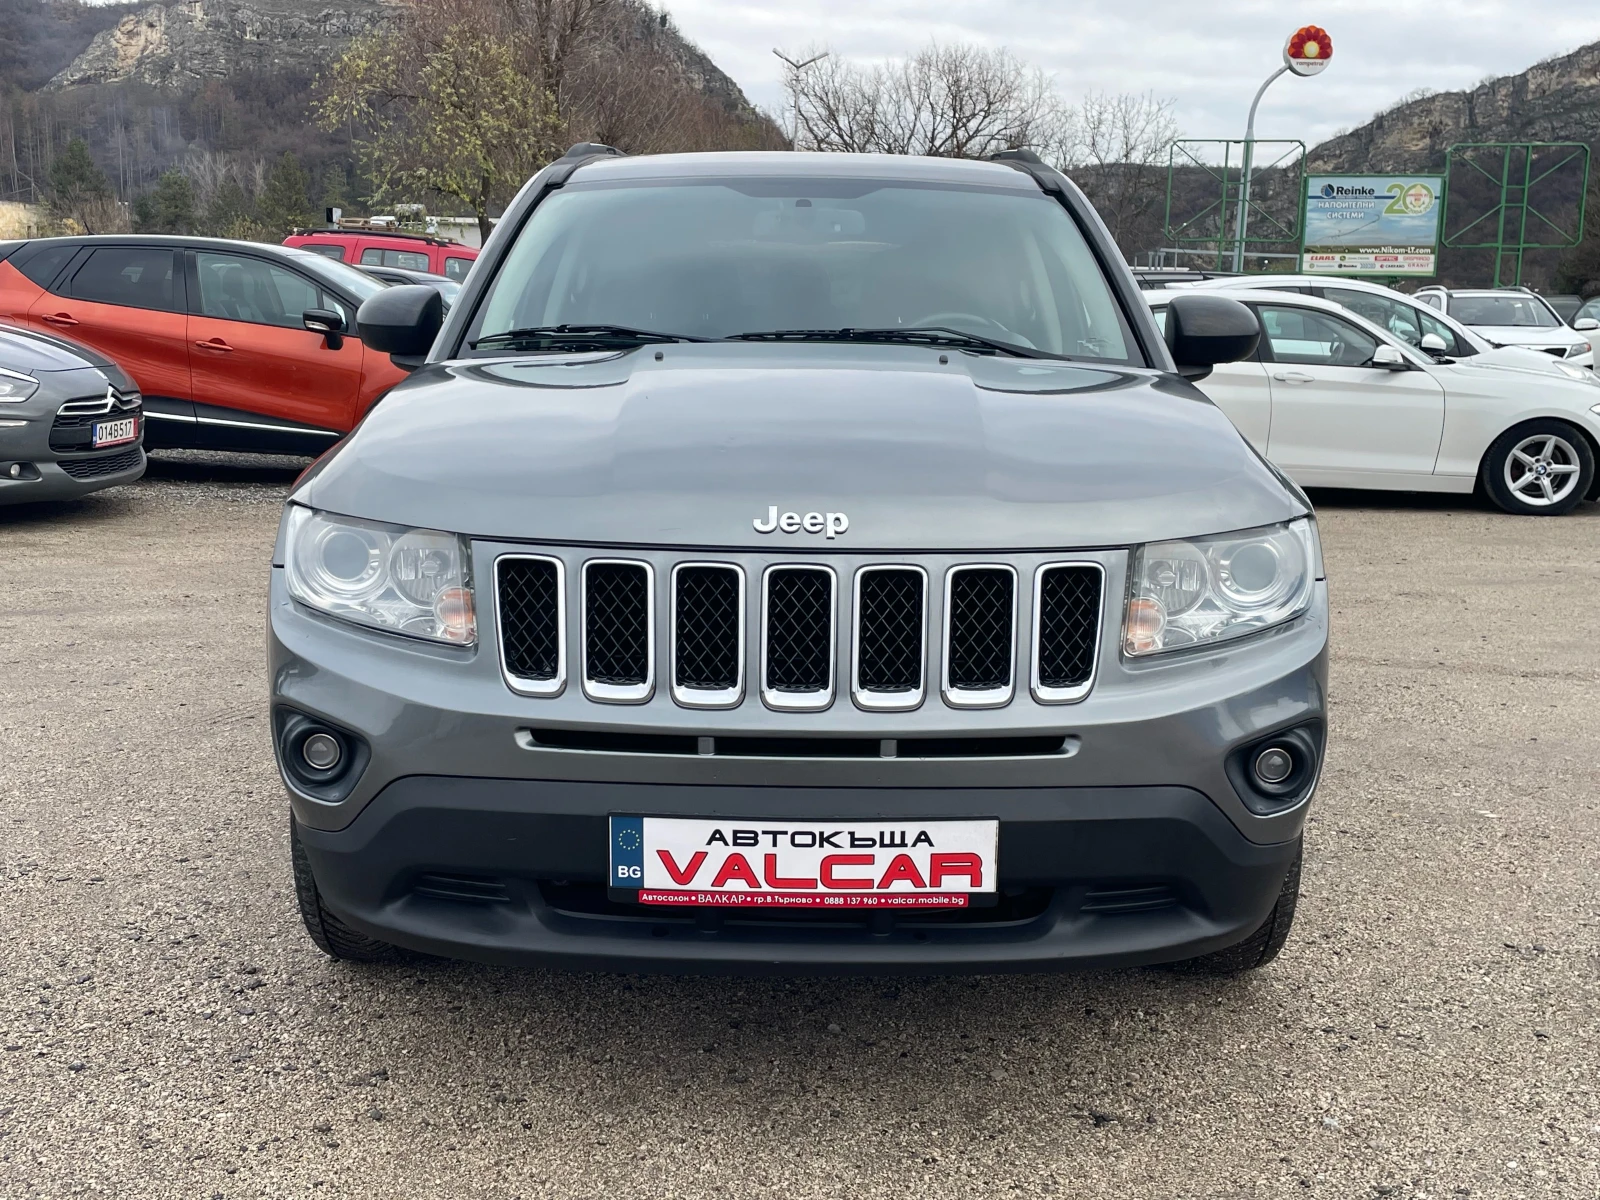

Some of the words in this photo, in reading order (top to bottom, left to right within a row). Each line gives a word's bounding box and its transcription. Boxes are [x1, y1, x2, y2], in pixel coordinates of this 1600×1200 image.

[1336, 185, 1376, 196] Reinke
[1318, 201, 1376, 209] НАПОИТЕЛНИ
[1326, 211, 1365, 219] СИСТЕМИ
[1359, 246, 1431, 254] www.Nikom-LT.com
[98, 420, 132, 441] 014B517
[753, 505, 849, 540] Jeep
[706, 829, 935, 849] АВТОКЪЩА
[618, 865, 642, 879] BG
[656, 849, 983, 889] VALCAR
[641, 893, 690, 903] Автосалон
[698, 893, 746, 904] ВАЛКАР
[824, 896, 844, 905] 0888
[846, 896, 861, 905] 137
[863, 896, 878, 905] 960
[887, 895, 965, 906] valcar.mobile.bg
